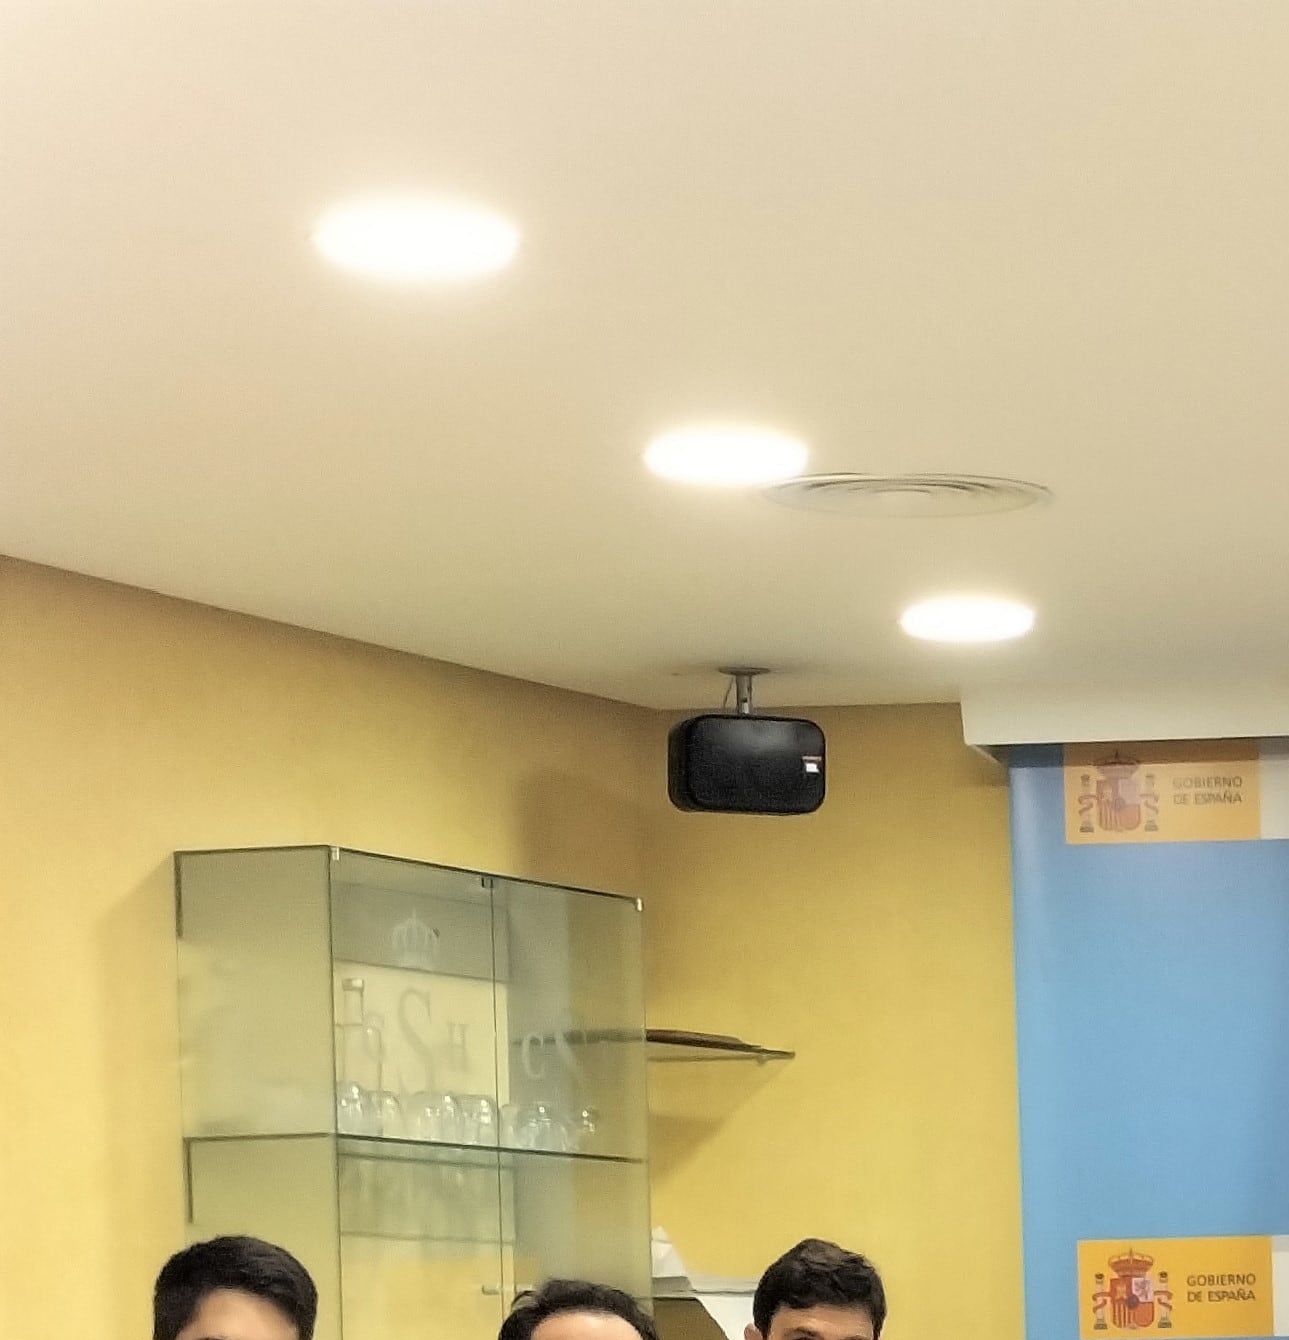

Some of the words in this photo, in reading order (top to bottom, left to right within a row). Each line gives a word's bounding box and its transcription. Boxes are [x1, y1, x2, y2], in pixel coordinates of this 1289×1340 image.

[1173, 775, 1242, 789] GOBIERNO
[1173, 793, 1187, 805] DE
[1194, 790, 1242, 805] ESPAÑA
[1187, 1273, 1256, 1287] GOBIERNO
[1187, 1291, 1202, 1302] DE
[1208, 1288, 1256, 1303] ESPAÑA
